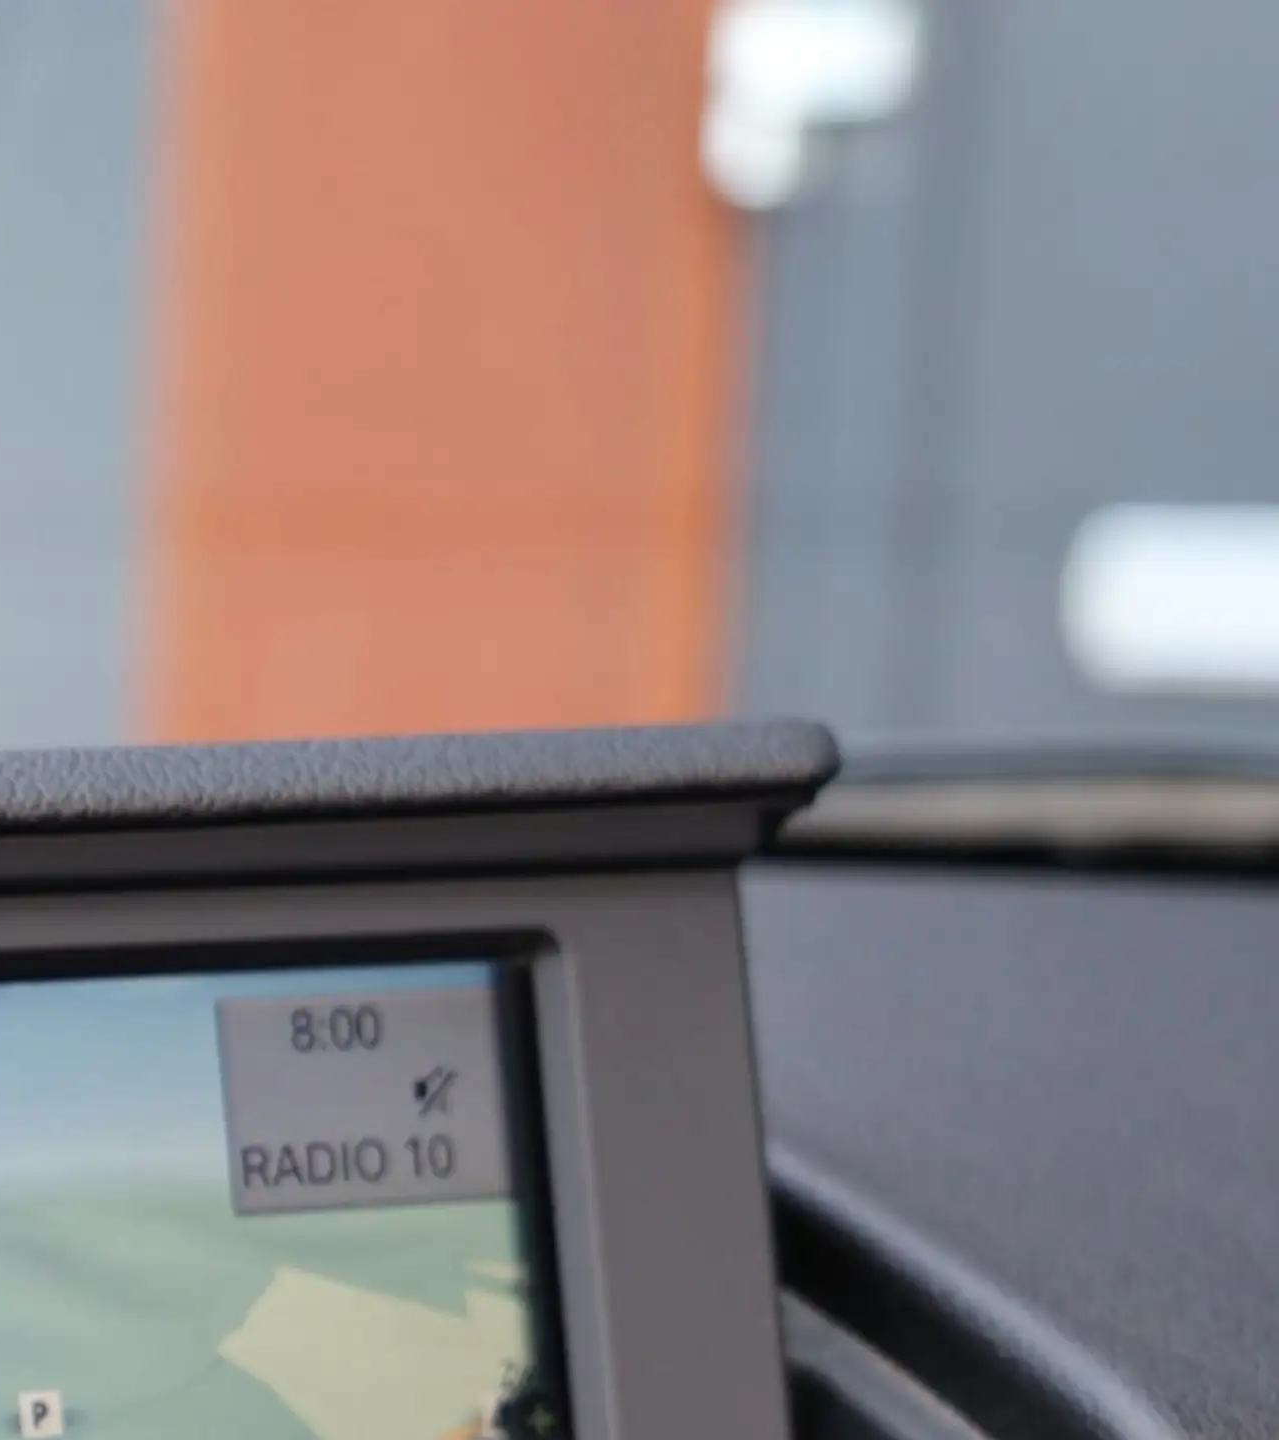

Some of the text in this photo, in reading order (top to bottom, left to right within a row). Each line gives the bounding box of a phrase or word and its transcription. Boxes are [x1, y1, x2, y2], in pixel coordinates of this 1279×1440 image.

[290, 1005, 383, 1053] 8:00
[241, 1132, 455, 1190] RADIO 10
